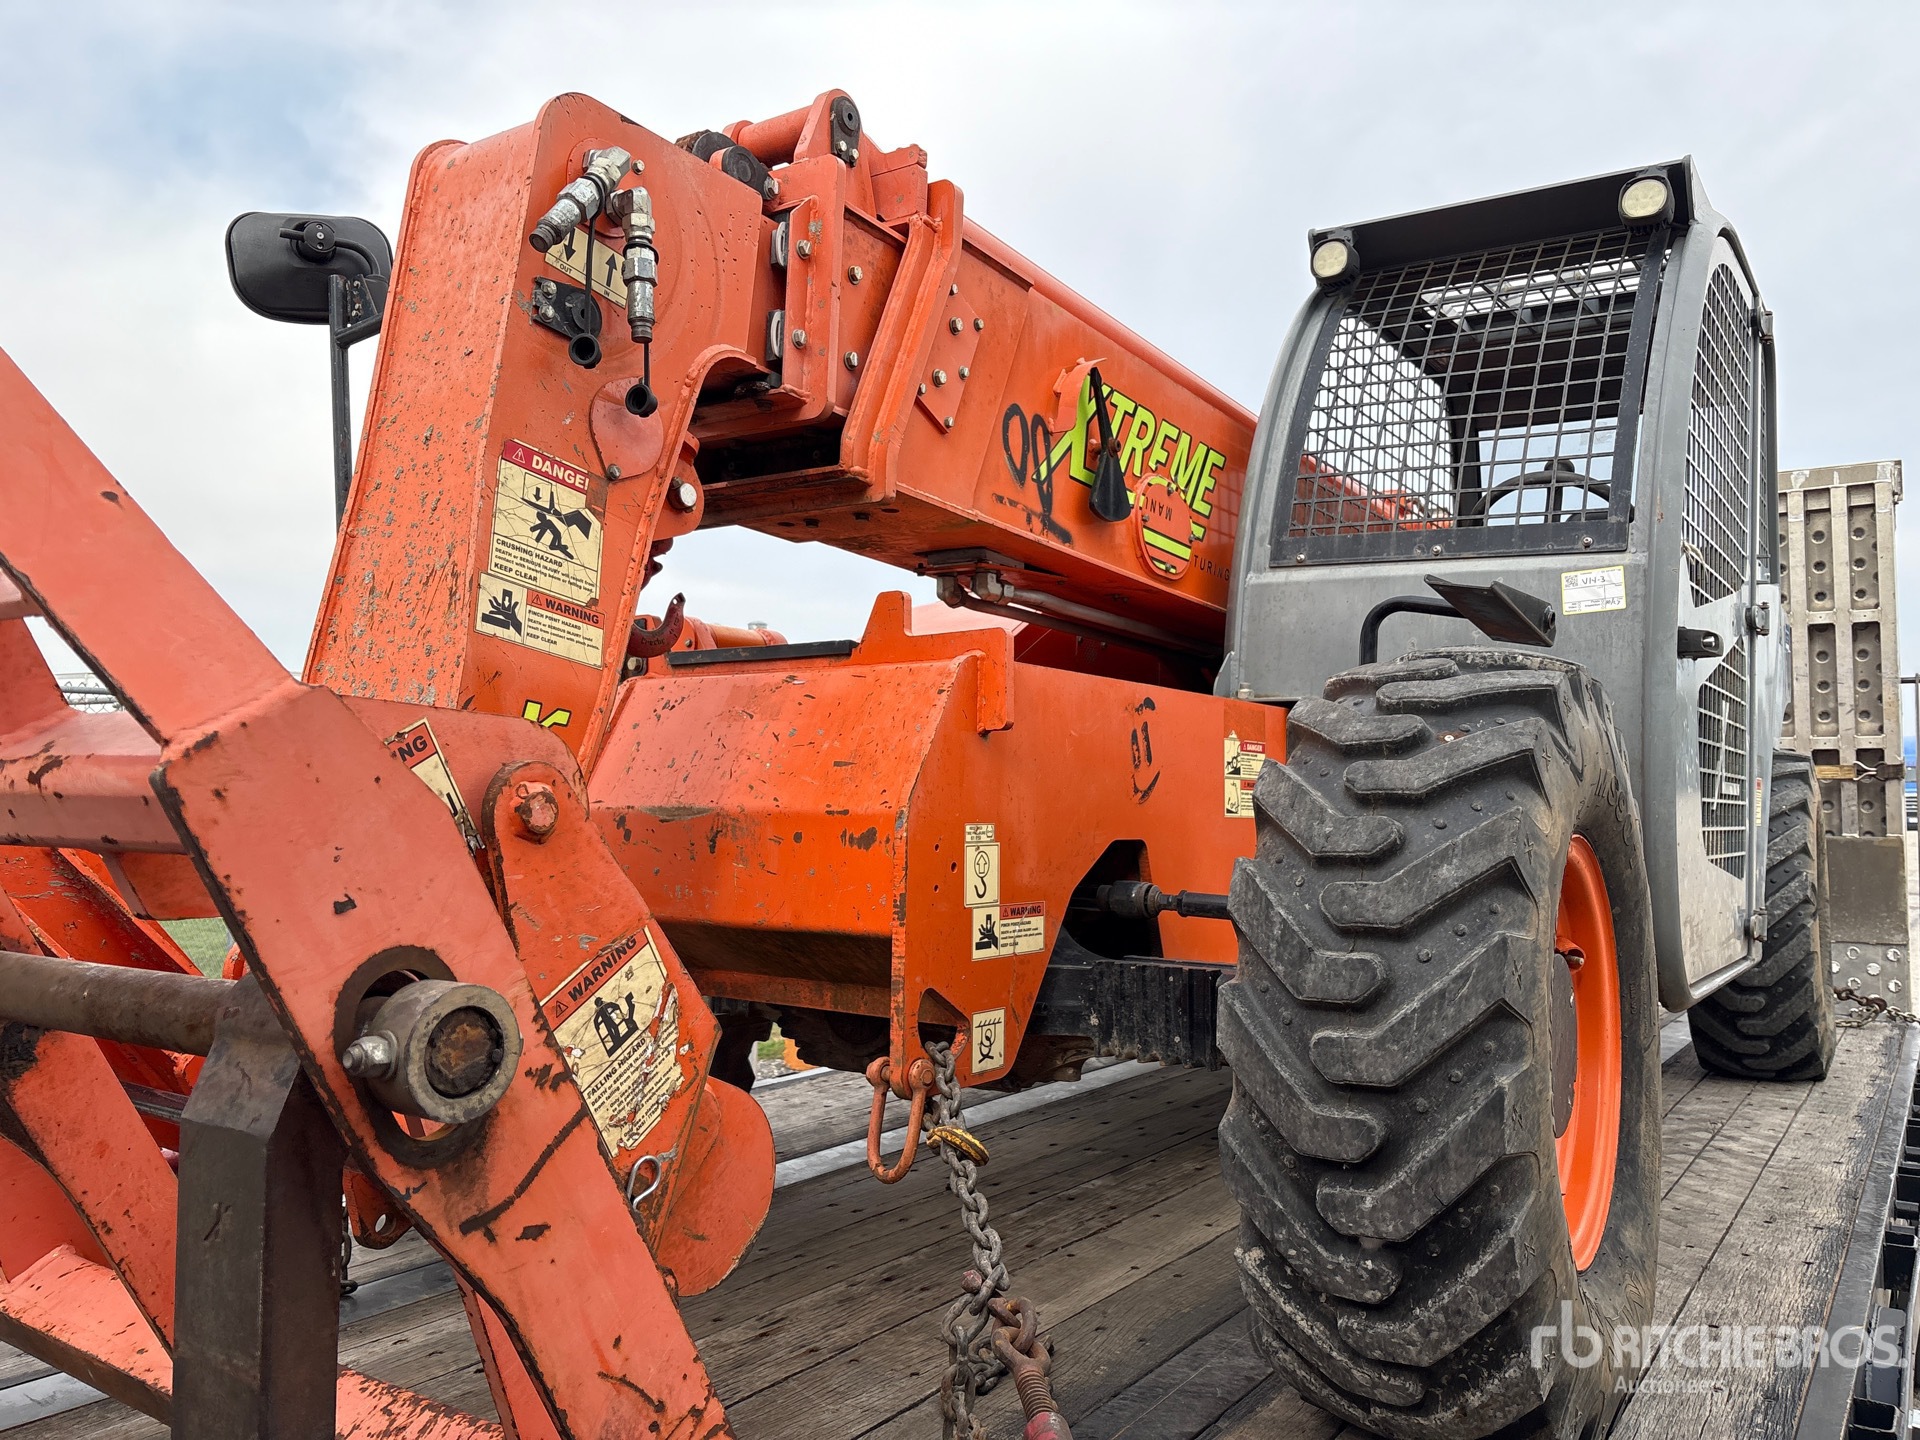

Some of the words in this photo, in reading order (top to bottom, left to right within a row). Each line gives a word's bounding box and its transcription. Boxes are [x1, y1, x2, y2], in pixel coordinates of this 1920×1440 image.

[560, 263, 572, 274] OUT
[1032, 373, 1226, 519] XTREME
[494, 553, 514, 564] contact
[495, 547, 512, 557] DEATH
[519, 556, 540, 567] SERIOUS
[542, 564, 560, 574] INJURY
[496, 537, 533, 557] CRUSHING
[534, 552, 562, 568] HAZARD
[494, 561, 512, 574] KEEP
[514, 569, 537, 583] CLEAR
[528, 609, 543, 618] PINCH
[544, 614, 560, 623] POINT
[561, 620, 581, 630] HAZARD
[545, 598, 599, 624] WARNING
[526, 631, 539, 640] KEEP
[540, 636, 557, 645] CLEAR
[1010, 905, 1040, 916] WARNING
[568, 936, 636, 1002] WARNING
[586, 1066, 617, 1099] FALLING
[617, 1036, 646, 1068] HAZARD
[591, 1088, 607, 1106] DEATH
[612, 1061, 633, 1084] SERIOUS
[594, 1099, 605, 1112] from
[604, 1084, 620, 1101] falling
[619, 1073, 630, 1086] from
